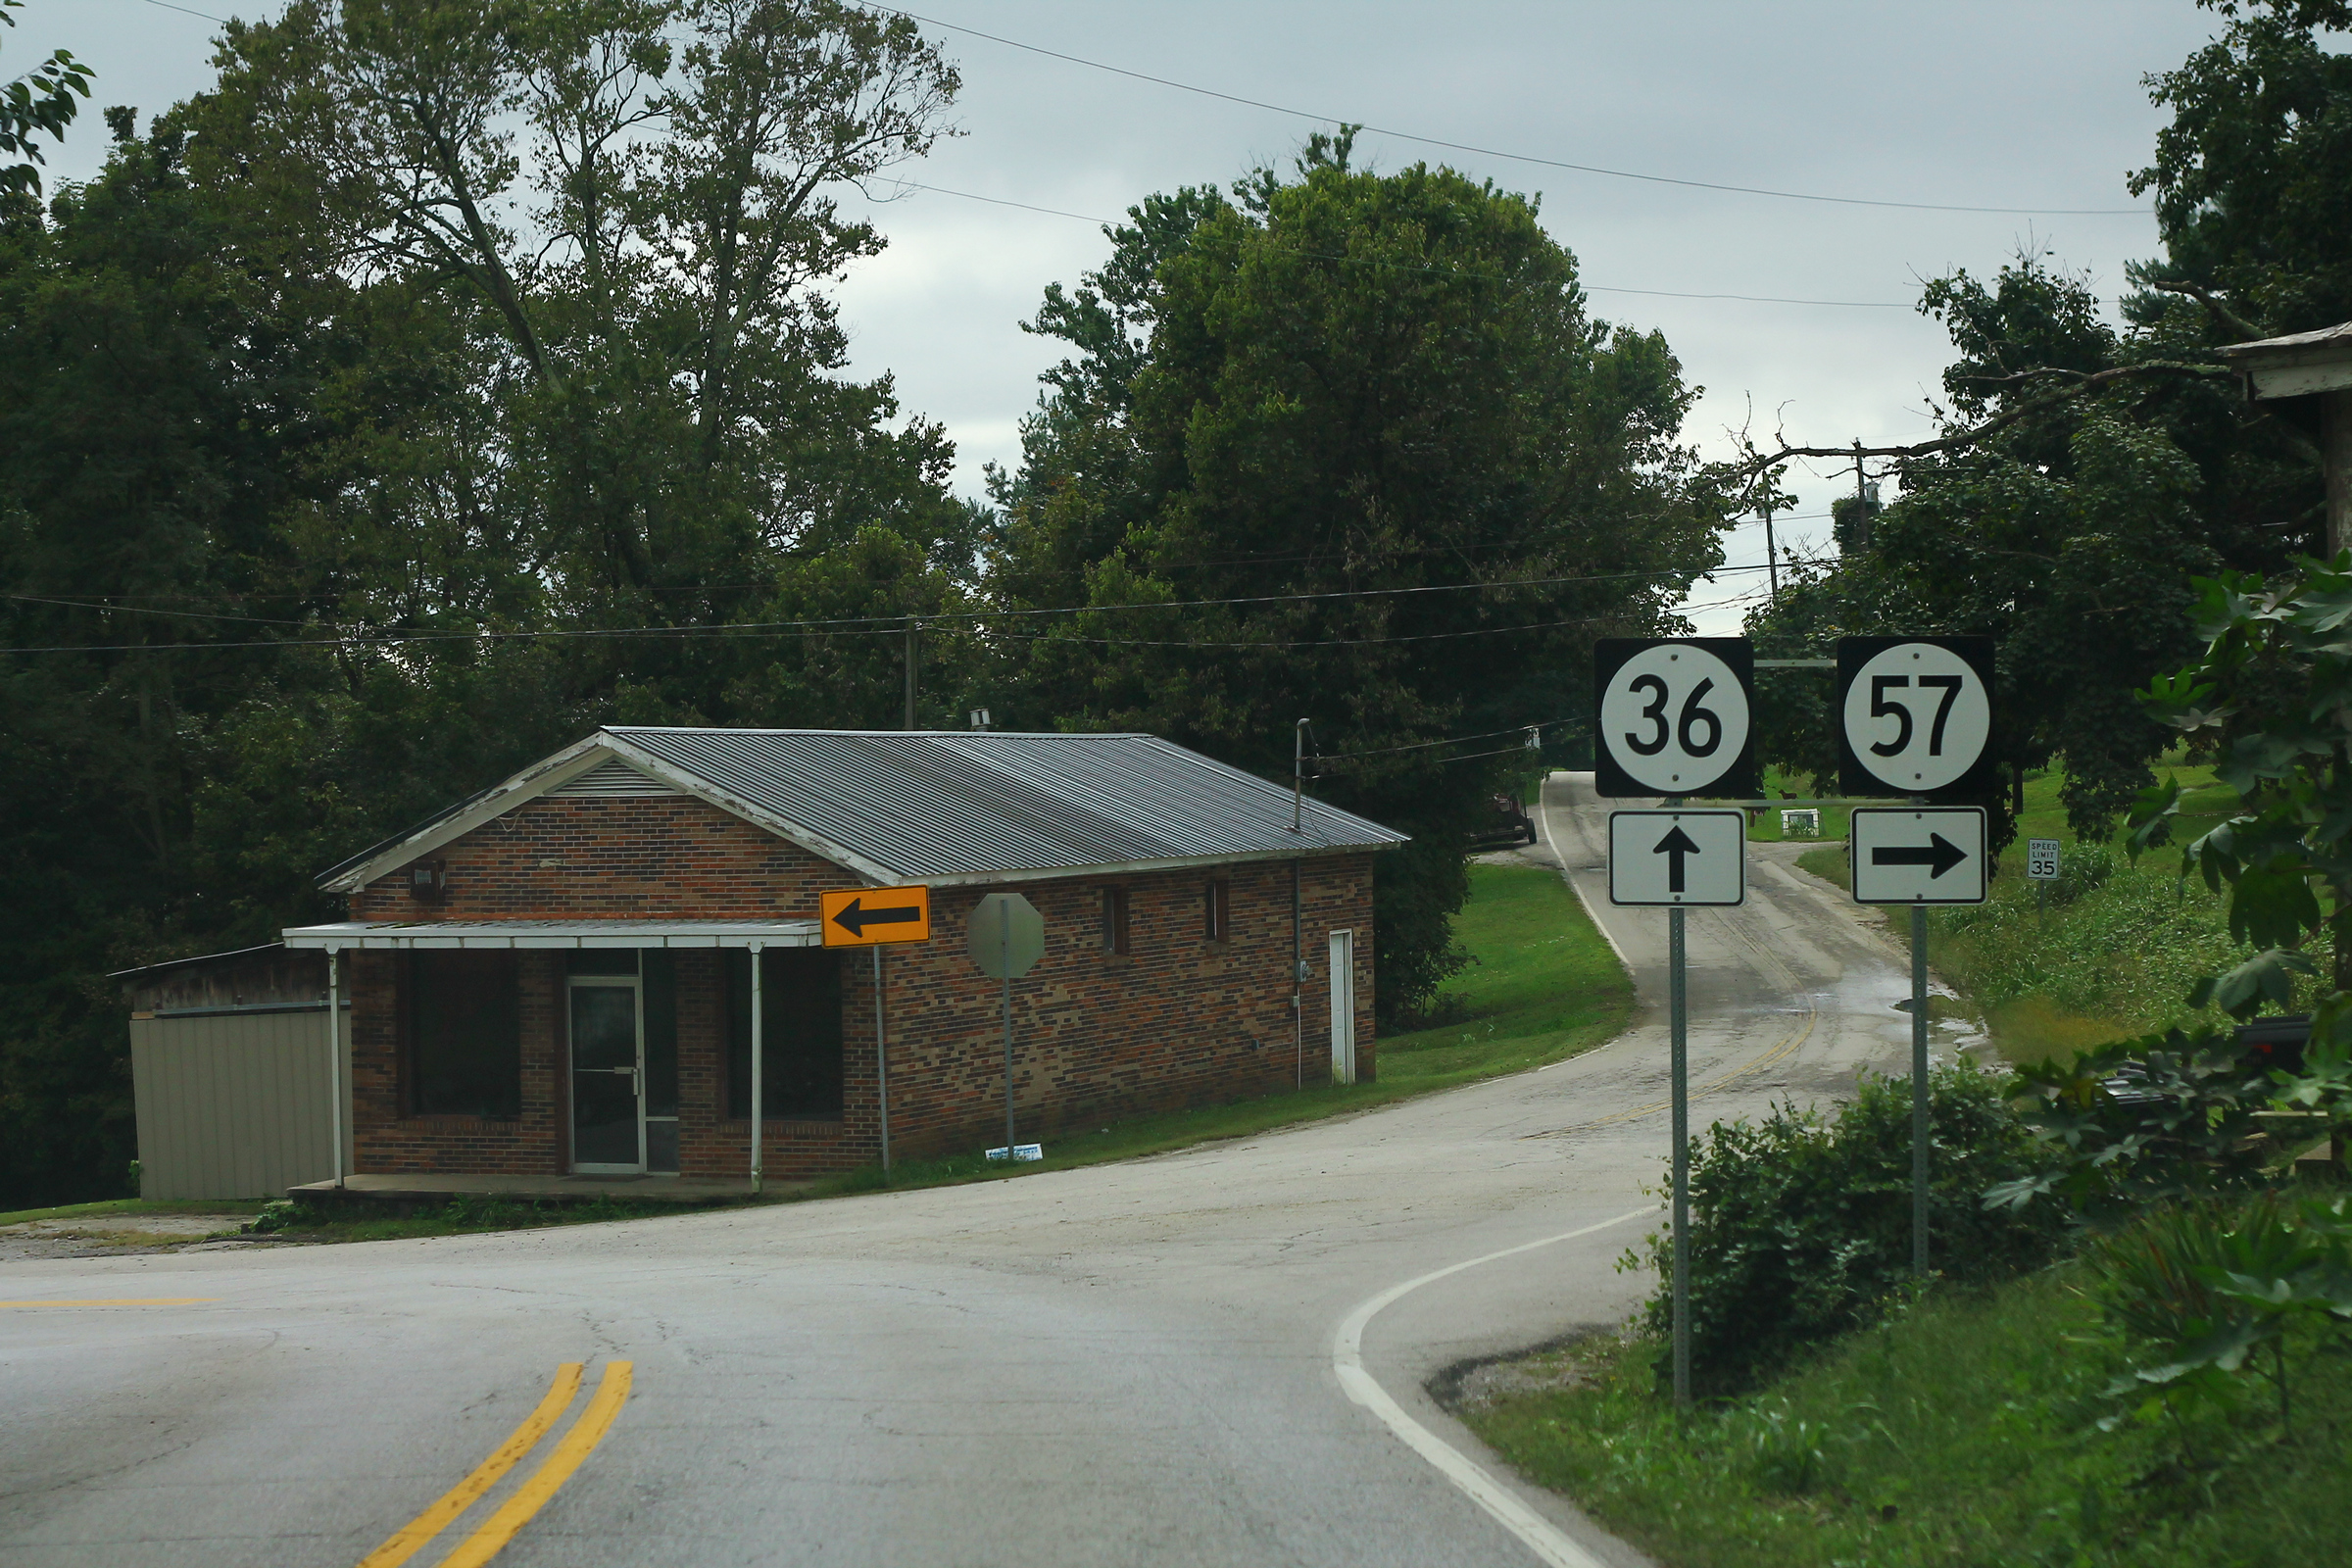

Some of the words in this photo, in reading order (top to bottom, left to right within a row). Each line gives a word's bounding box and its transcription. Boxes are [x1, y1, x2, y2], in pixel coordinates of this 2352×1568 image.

[1624, 673, 1723, 759] 36
[1869, 674, 1963, 758] 57
[2031, 859, 2055, 875] 35
